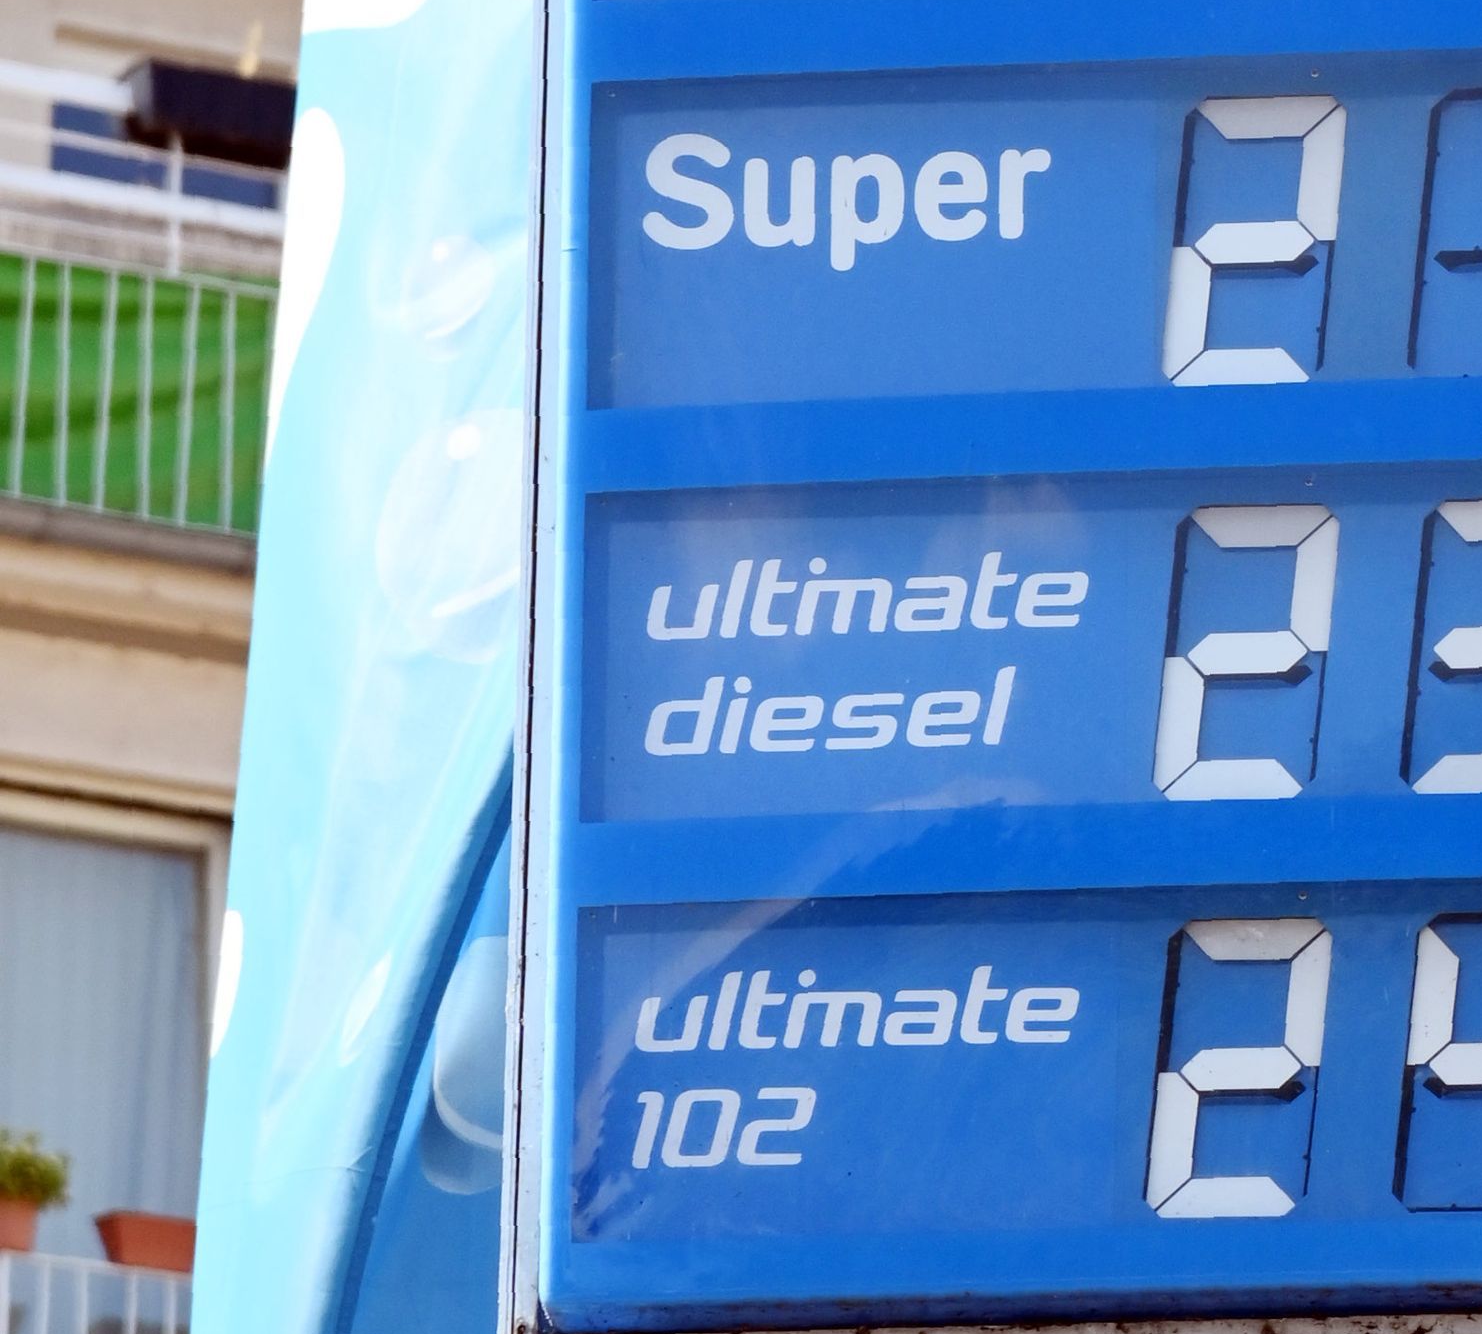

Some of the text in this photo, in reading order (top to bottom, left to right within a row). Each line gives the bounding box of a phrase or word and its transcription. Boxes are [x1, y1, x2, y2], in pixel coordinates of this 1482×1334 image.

[642, 133, 1052, 272] Super
[646, 551, 1089, 641] ultimate
[644, 665, 1017, 756] diesel
[634, 965, 1080, 1053] ultimate
[631, 1086, 817, 1169] 102
